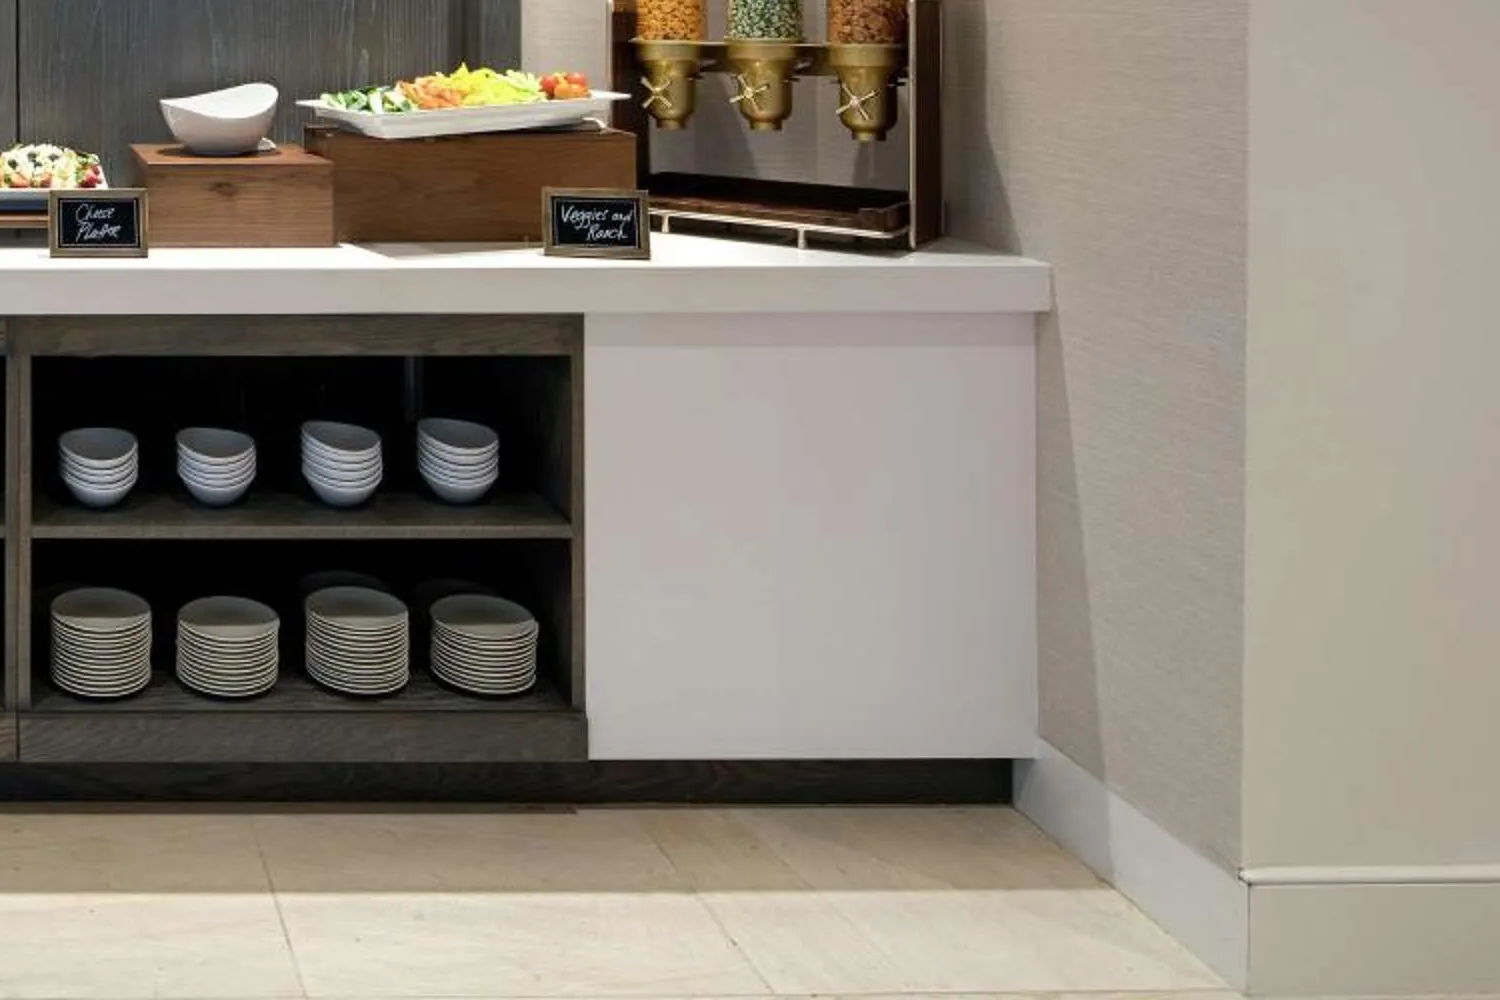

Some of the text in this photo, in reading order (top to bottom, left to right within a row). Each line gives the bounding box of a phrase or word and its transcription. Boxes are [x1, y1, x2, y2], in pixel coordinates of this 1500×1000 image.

[561, 204, 633, 230] Veggies and
[75, 221, 121, 242] Platter
[585, 221, 628, 241] Ranch
